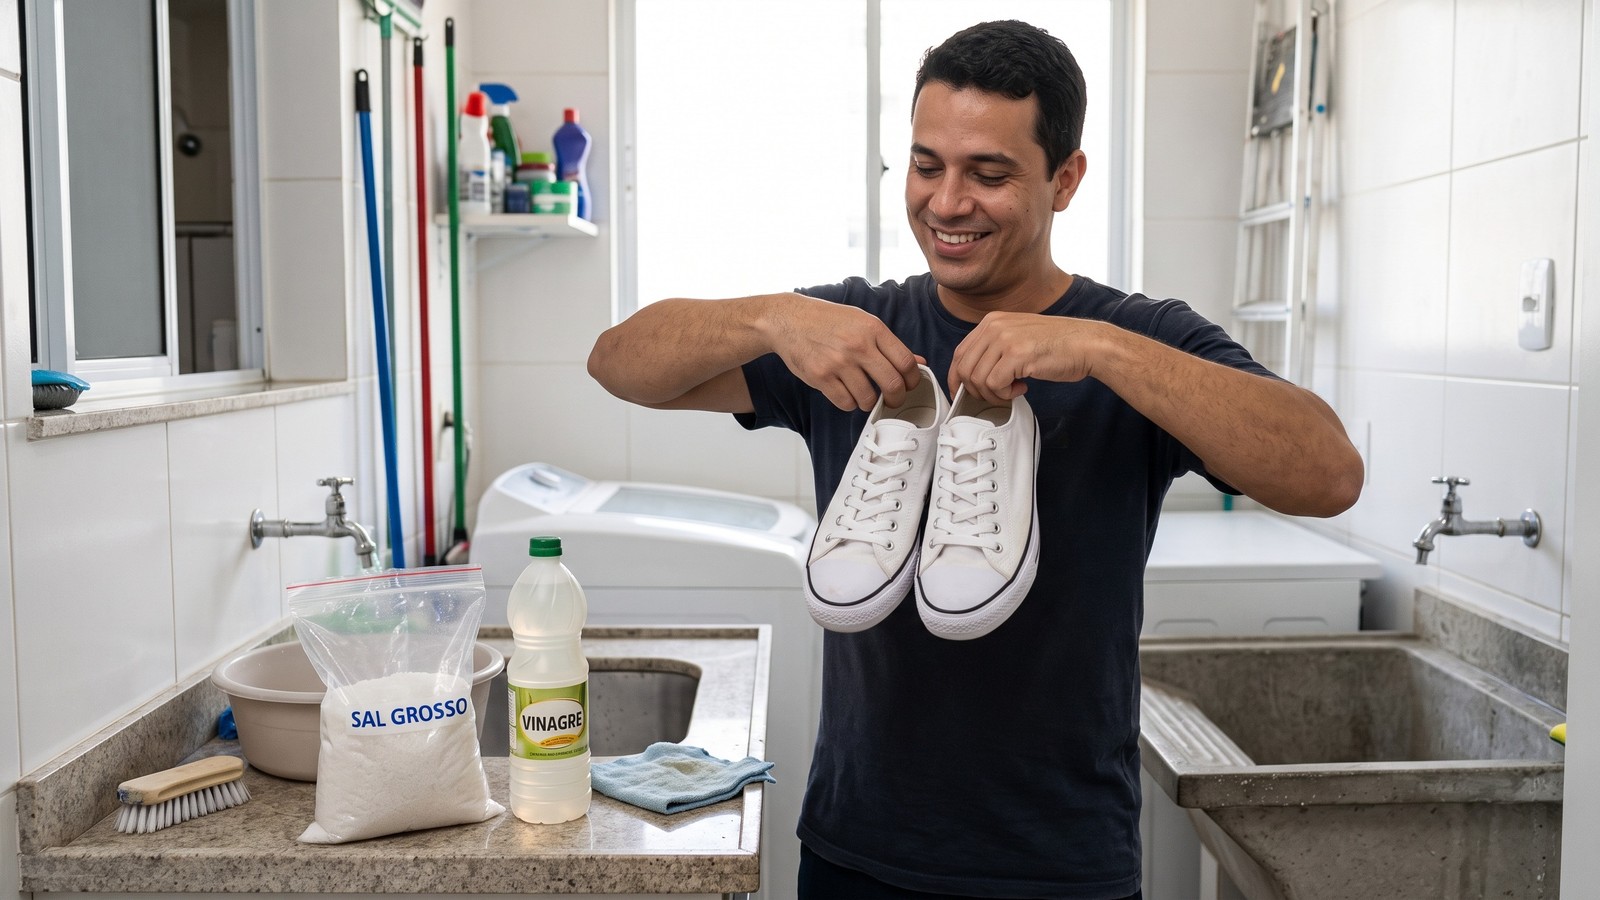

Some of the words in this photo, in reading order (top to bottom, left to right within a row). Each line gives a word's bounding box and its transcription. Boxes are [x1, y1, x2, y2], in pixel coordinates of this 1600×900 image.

[351, 710, 386, 728] SAL
[391, 698, 467, 725] GROSSO
[522, 711, 582, 732] VINAGRE
